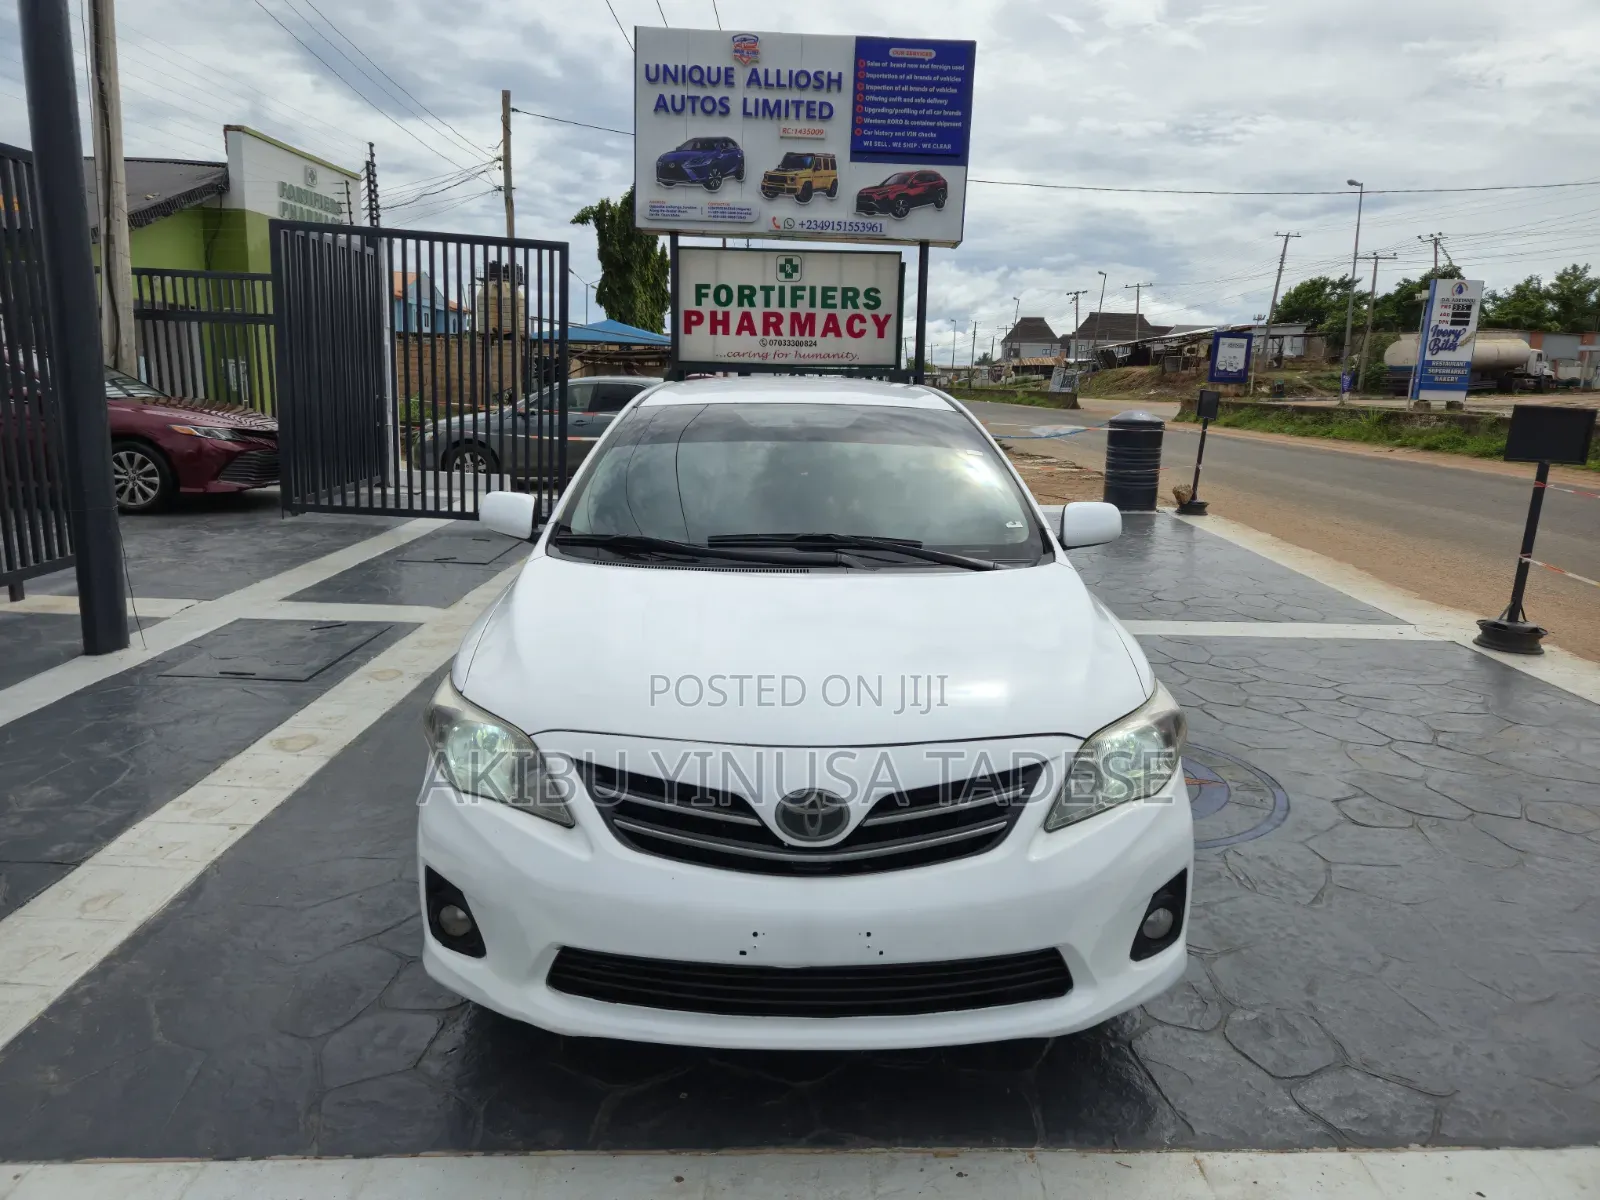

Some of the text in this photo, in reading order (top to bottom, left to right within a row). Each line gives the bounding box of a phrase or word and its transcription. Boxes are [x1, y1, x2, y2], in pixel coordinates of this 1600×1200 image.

[644, 64, 843, 92] UNIQUE ALLIOSH
[654, 94, 834, 120] AUTOS LIMITED
[799, 220, 883, 233] +2349151553961
[695, 283, 882, 311] FORTIFIERS
[683, 310, 893, 339] PHARMACY
[1431, 324, 1467, 342] Ivory
[773, 350, 791, 360] for
[1429, 338, 1460, 356] Bites
